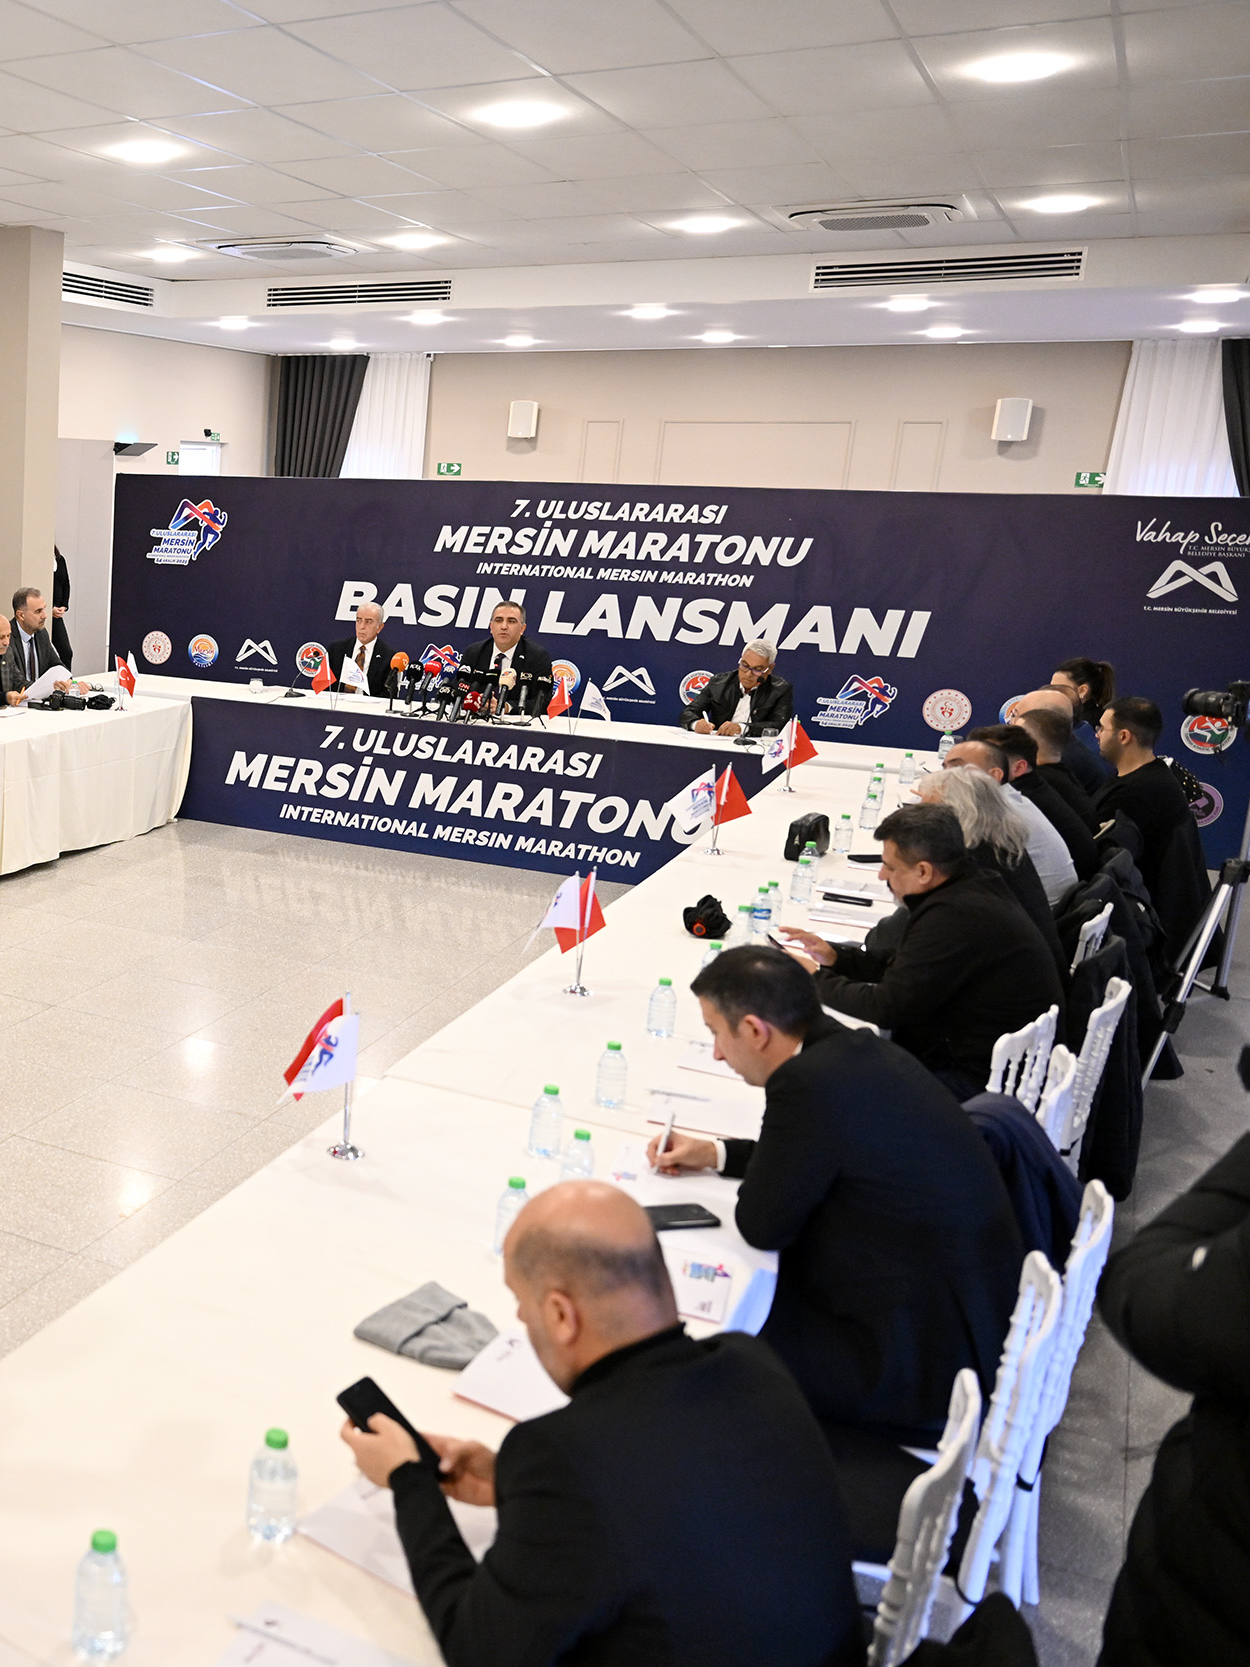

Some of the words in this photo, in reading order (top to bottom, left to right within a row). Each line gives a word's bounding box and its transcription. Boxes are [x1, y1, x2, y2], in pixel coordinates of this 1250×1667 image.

[511, 500, 531, 518] 7.
[537, 500, 728, 524] ULUSLARARASI
[153, 546, 193, 555] MARATONU
[162, 537, 196, 547] MERSİN
[434, 521, 578, 557] MERSİN
[578, 530, 815, 566] MARATONU
[1136, 517, 1199, 554] Vahap
[476, 562, 594, 580] INTERNATIONAL
[596, 568, 658, 582] MERSIN
[659, 571, 754, 588] MARATHON
[335, 581, 526, 629] BASIN
[538, 591, 931, 659] LANSMANI
[819, 712, 859, 720] MARATONU
[829, 705, 862, 713] MERSİN
[320, 725, 345, 749] 7.
[353, 728, 603, 778] ULUSLARARASI
[225, 751, 407, 805] MERSİN
[280, 804, 430, 838] INTERNATIONAL
[433, 825, 513, 849] MERSIN
[514, 836, 641, 867] MARATHON
